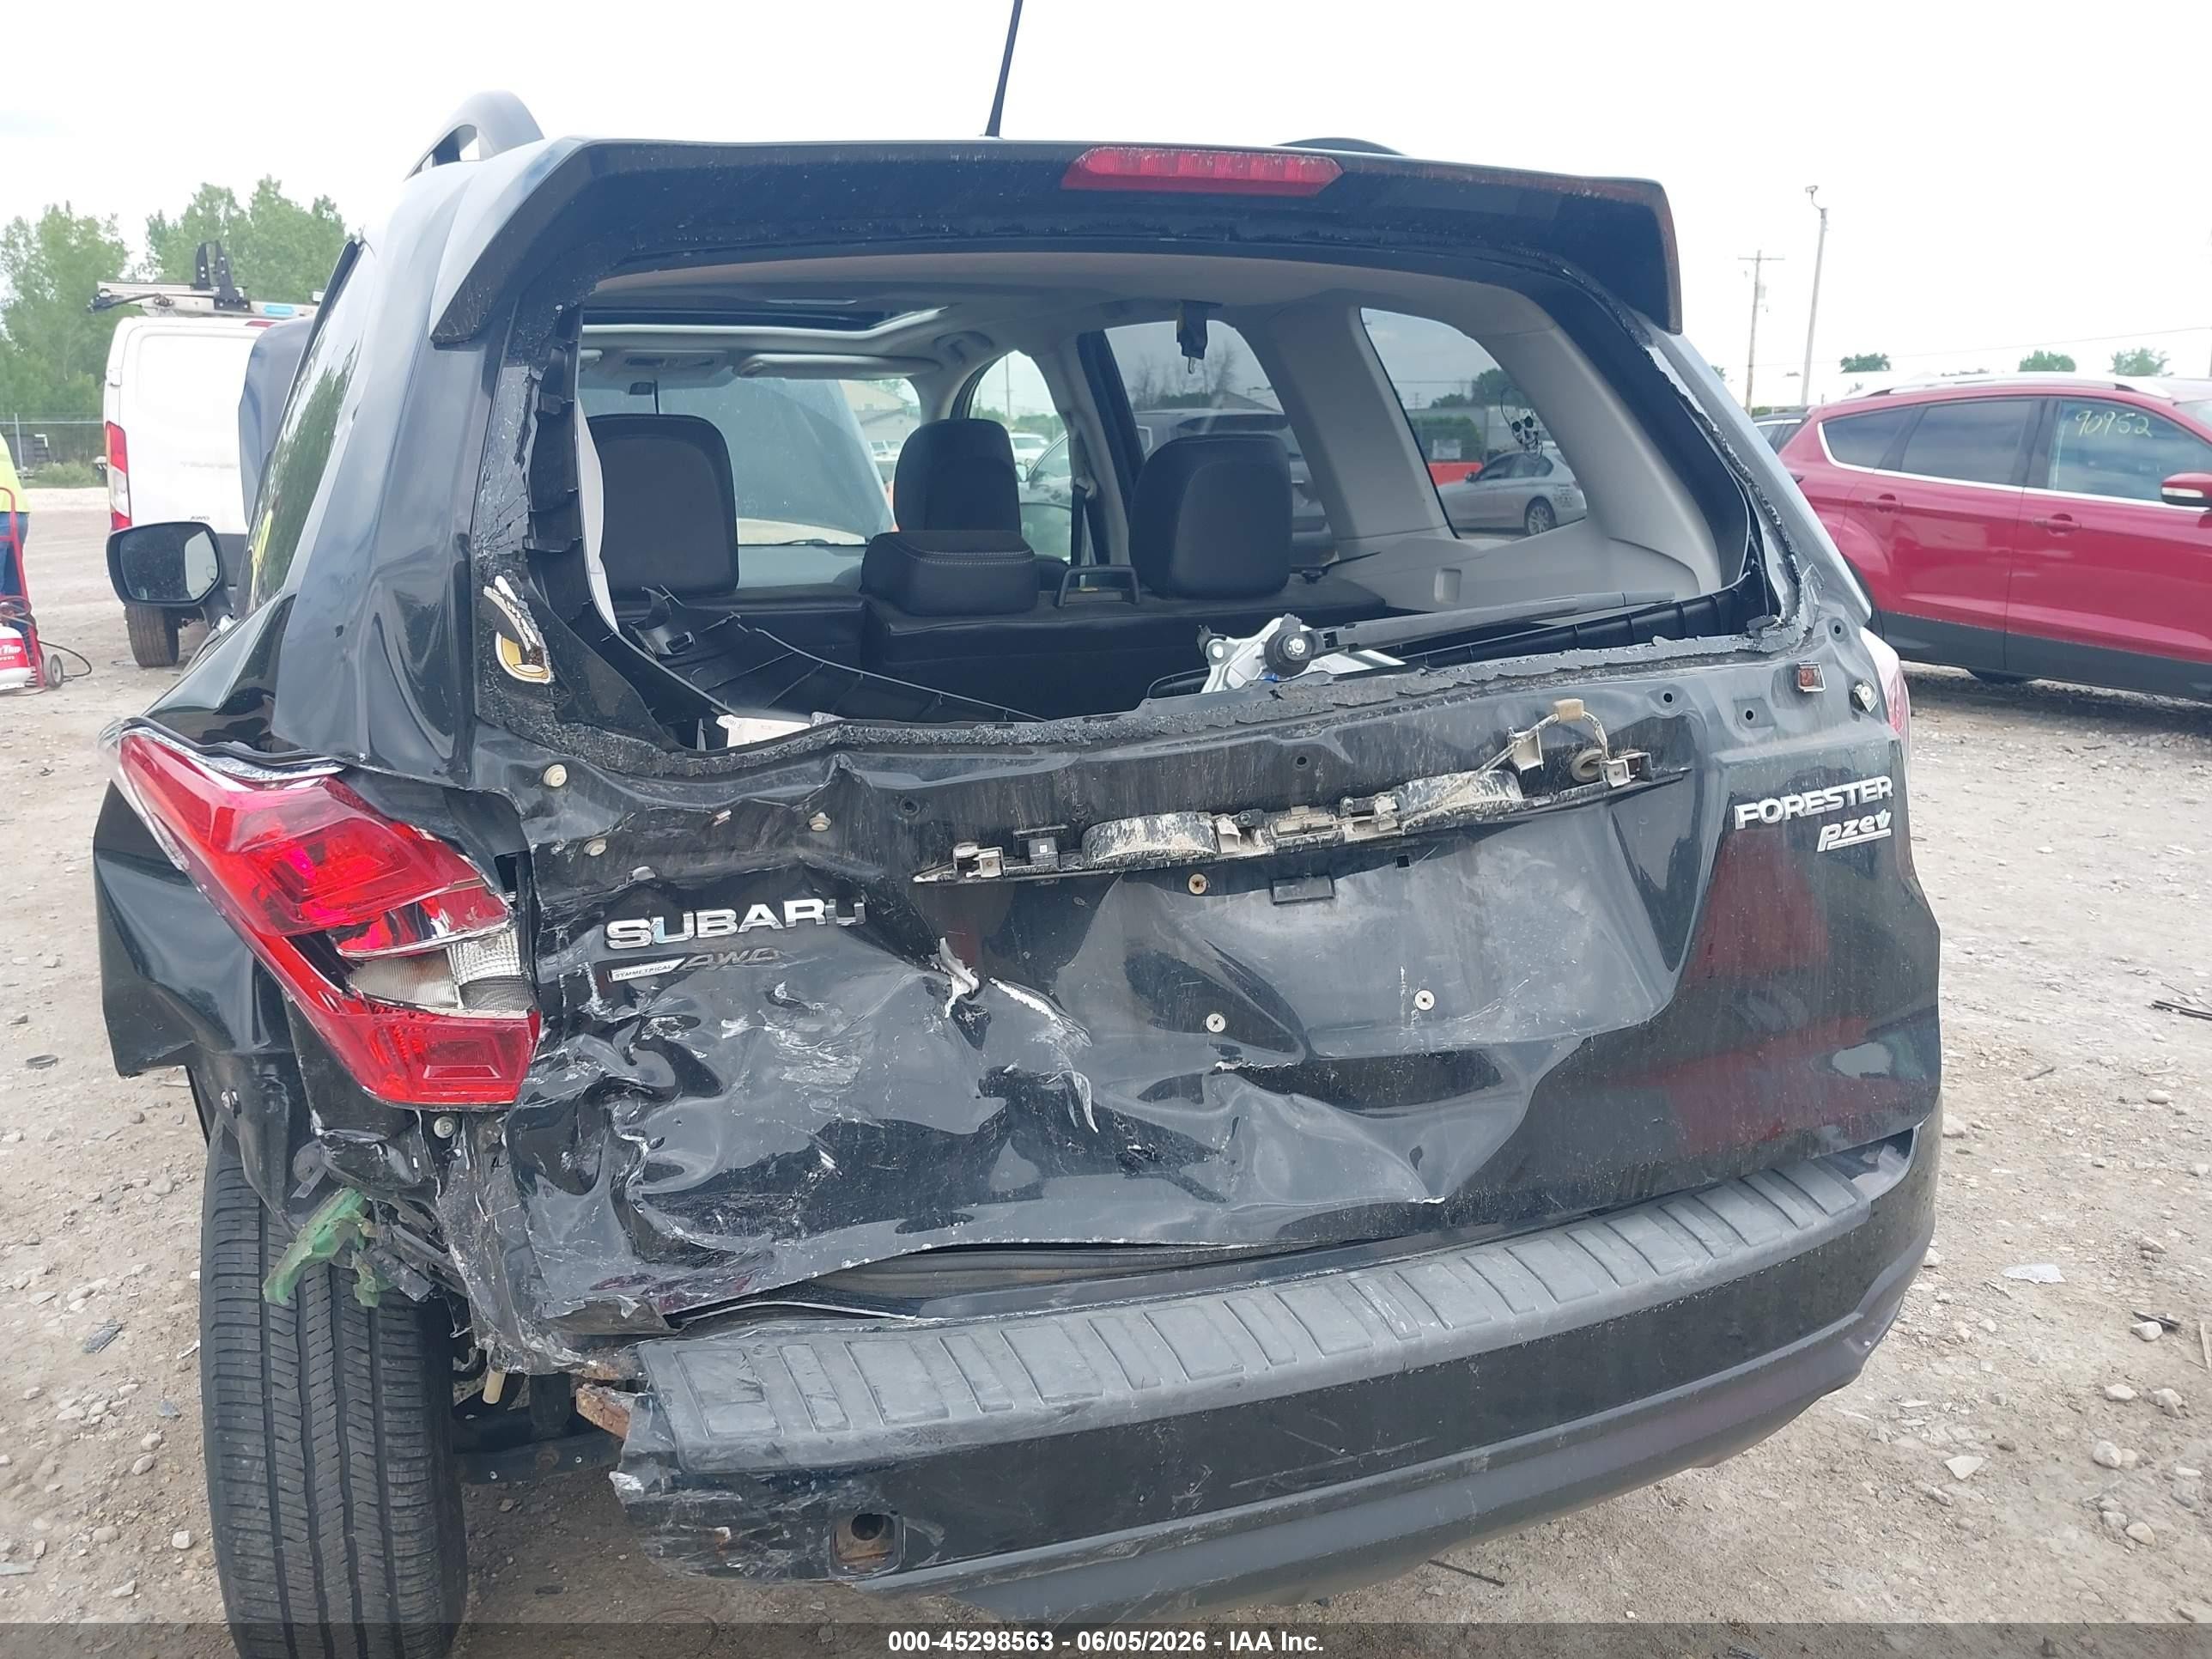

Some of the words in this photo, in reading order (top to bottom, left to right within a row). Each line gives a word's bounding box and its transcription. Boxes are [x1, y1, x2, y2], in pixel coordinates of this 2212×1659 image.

[2075, 410, 2152, 437] 90952
[1734, 775, 1893, 830] FORESTER
[606, 898, 866, 950] SUBARU
[614, 964, 673, 979] SYMMETRICAL
